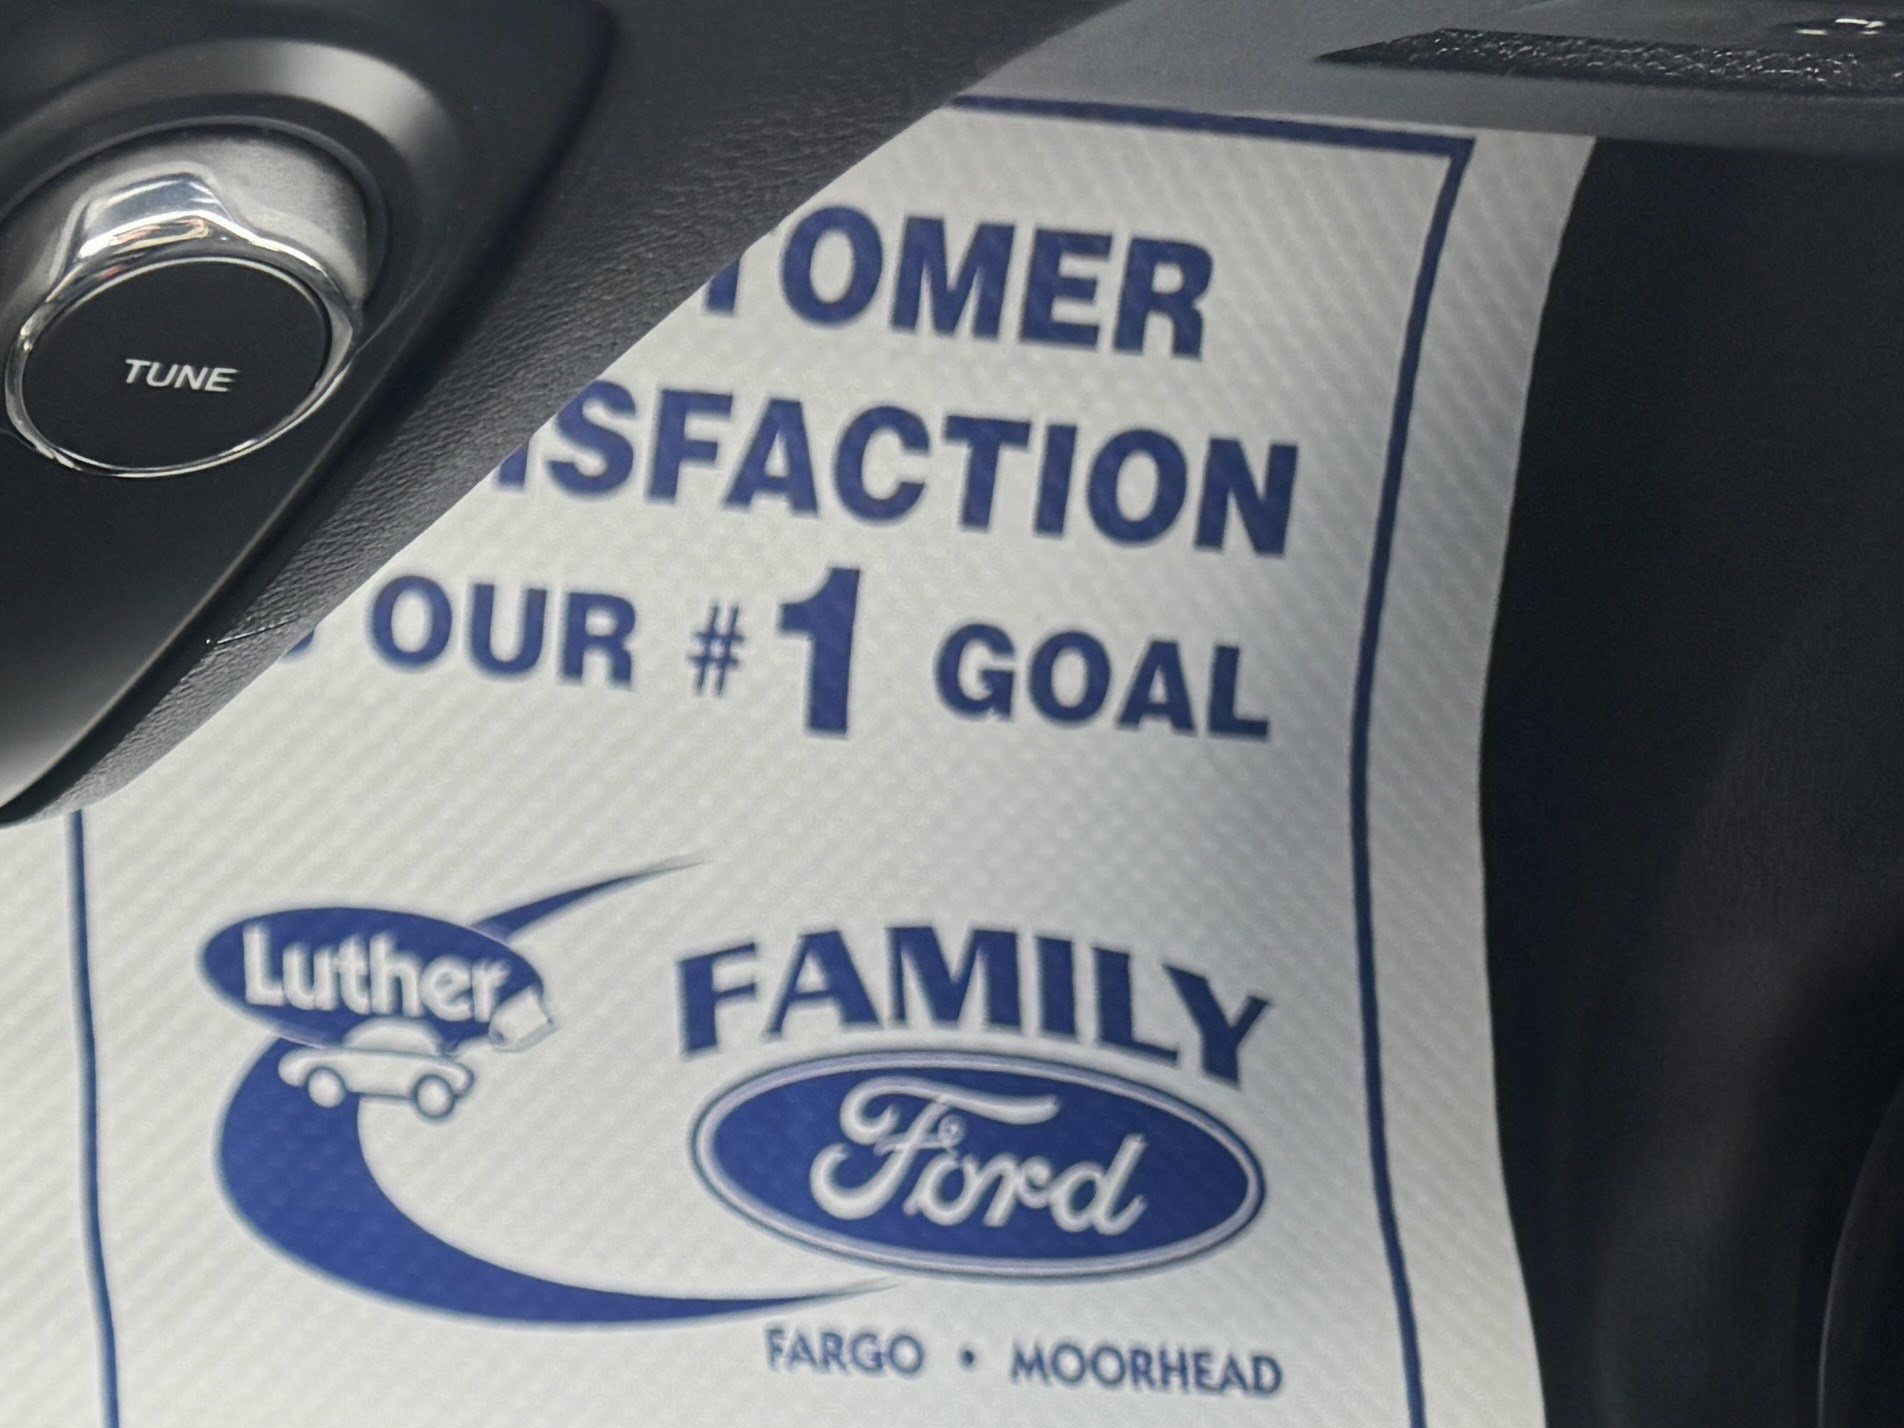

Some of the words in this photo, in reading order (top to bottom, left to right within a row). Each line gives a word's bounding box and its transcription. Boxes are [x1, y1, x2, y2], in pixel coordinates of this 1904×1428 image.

[123, 357, 239, 394] TUNE
[368, 574, 638, 690] OUR
[933, 621, 1270, 740] GOAL
[240, 923, 509, 1022] Luther
[675, 924, 1277, 1088] FAMILY
[808, 1074, 1151, 1238] Ford
[764, 1325, 924, 1378] FARGO
[1008, 1340, 1284, 1397] MOORHEAD
